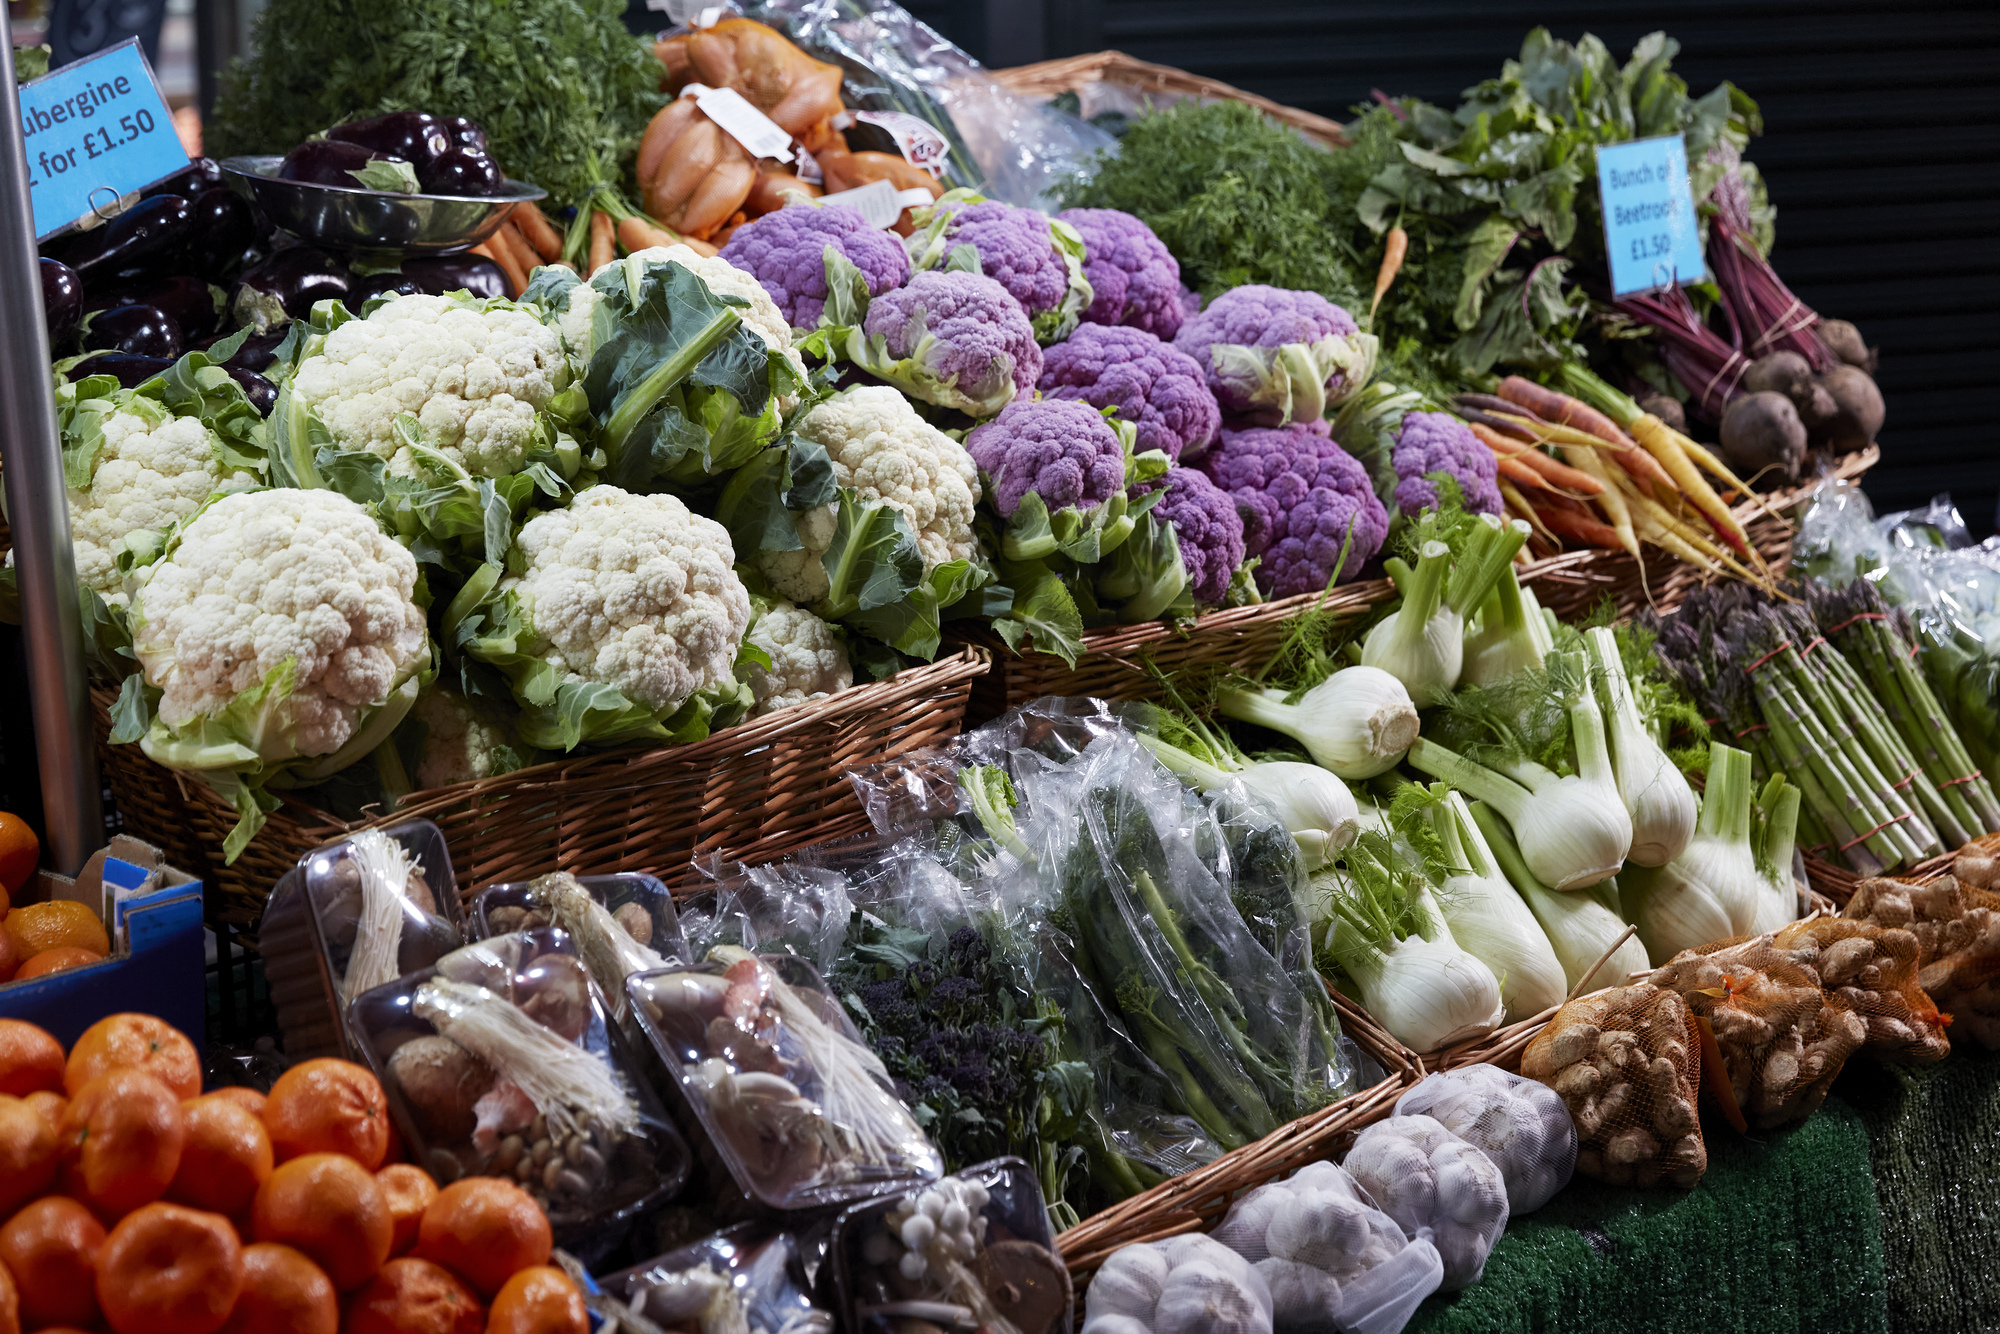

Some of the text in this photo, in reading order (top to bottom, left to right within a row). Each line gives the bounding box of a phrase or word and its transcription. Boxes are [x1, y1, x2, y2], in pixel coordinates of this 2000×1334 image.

[22, 75, 132, 137] ubergine
[39, 151, 77, 178] for
[84, 108, 155, 160] £1.50
[1610, 162, 1655, 190] Bunch
[1631, 233, 1671, 262] £1.50
